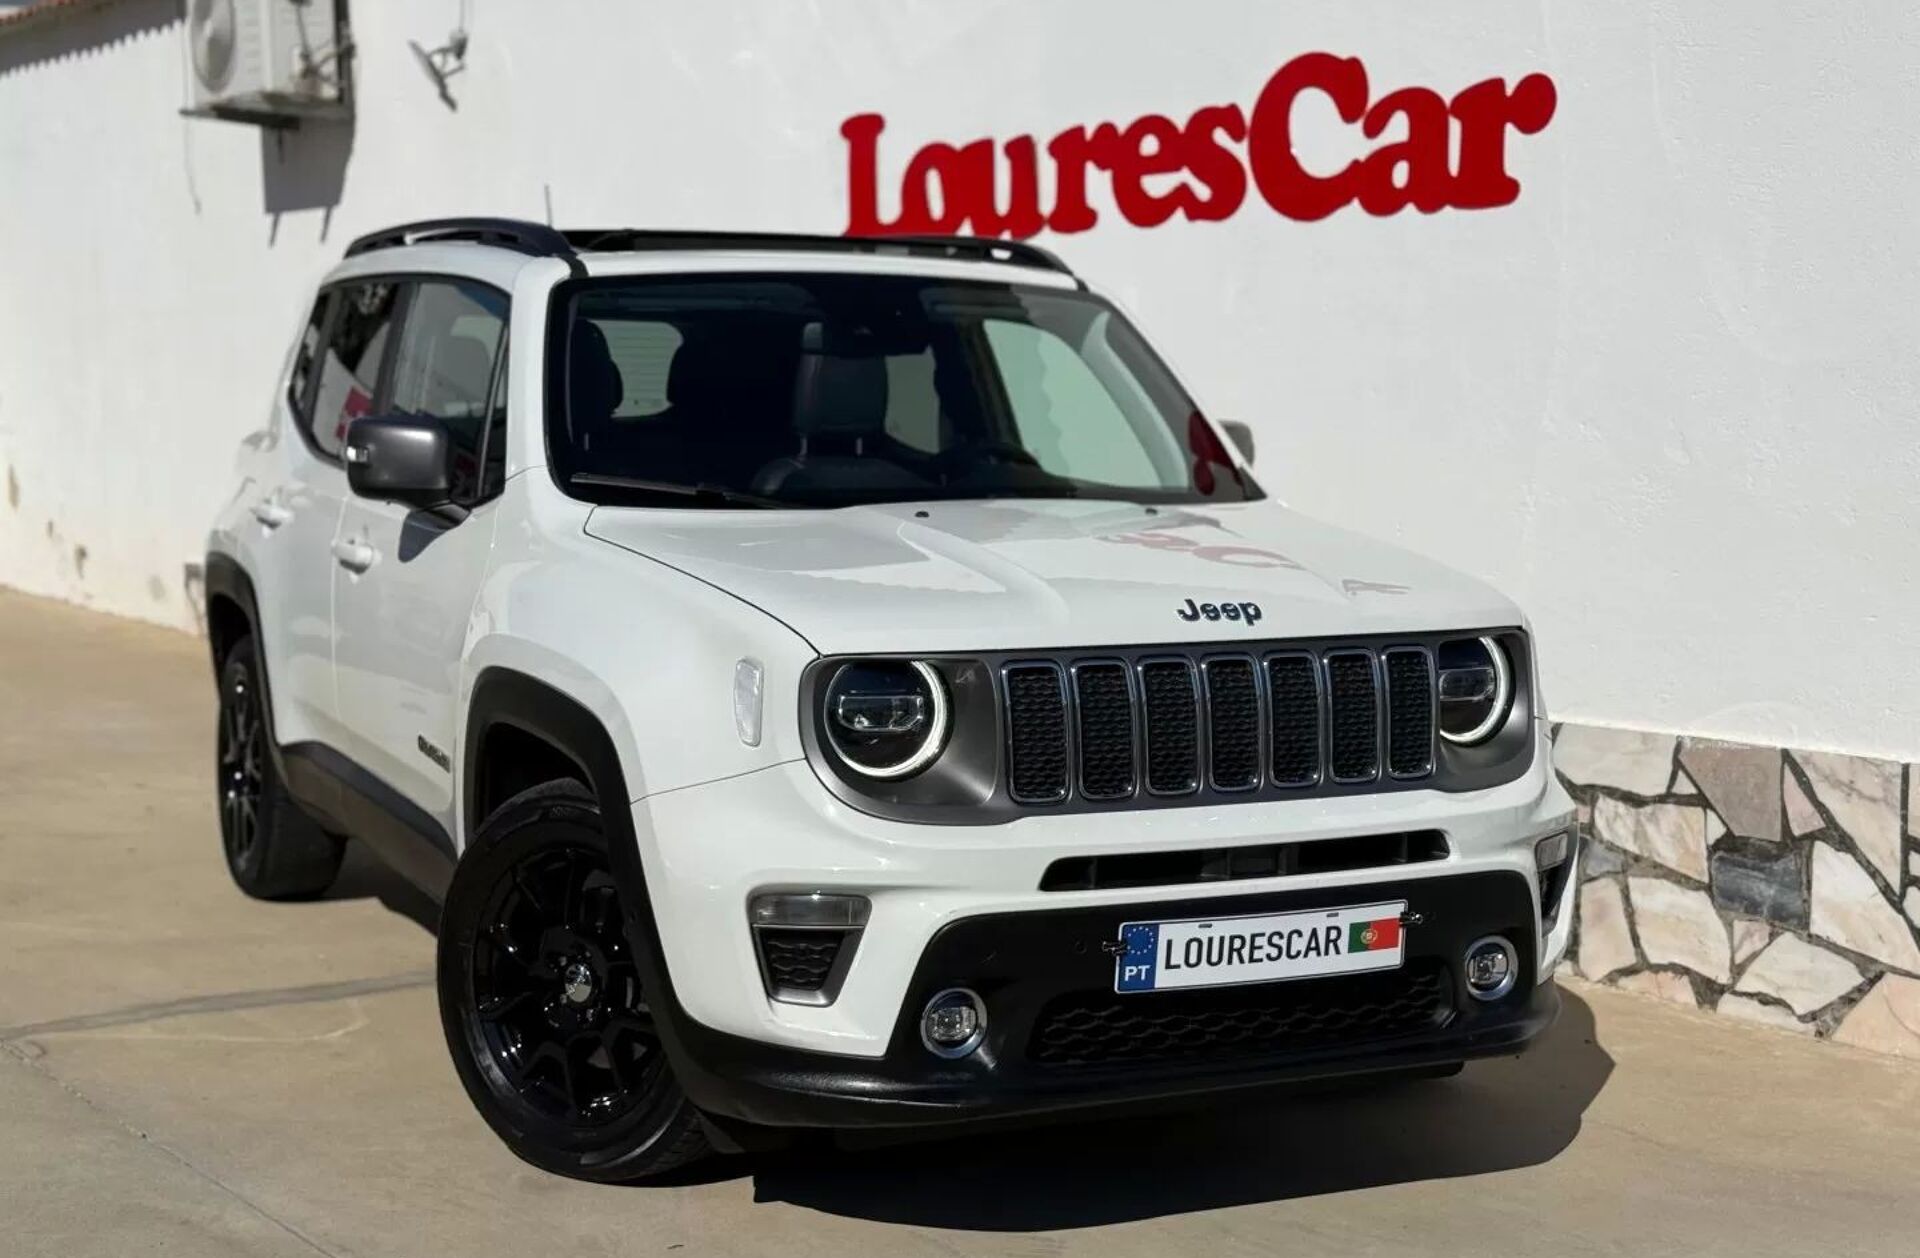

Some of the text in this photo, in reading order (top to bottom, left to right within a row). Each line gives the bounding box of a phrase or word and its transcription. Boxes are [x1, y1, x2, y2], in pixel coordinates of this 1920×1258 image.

[840, 52, 1557, 239] LouresCar
[1177, 598, 1262, 626] Jeep
[1164, 925, 1343, 970] LOURESCAR
[1124, 965, 1150, 982] PT
